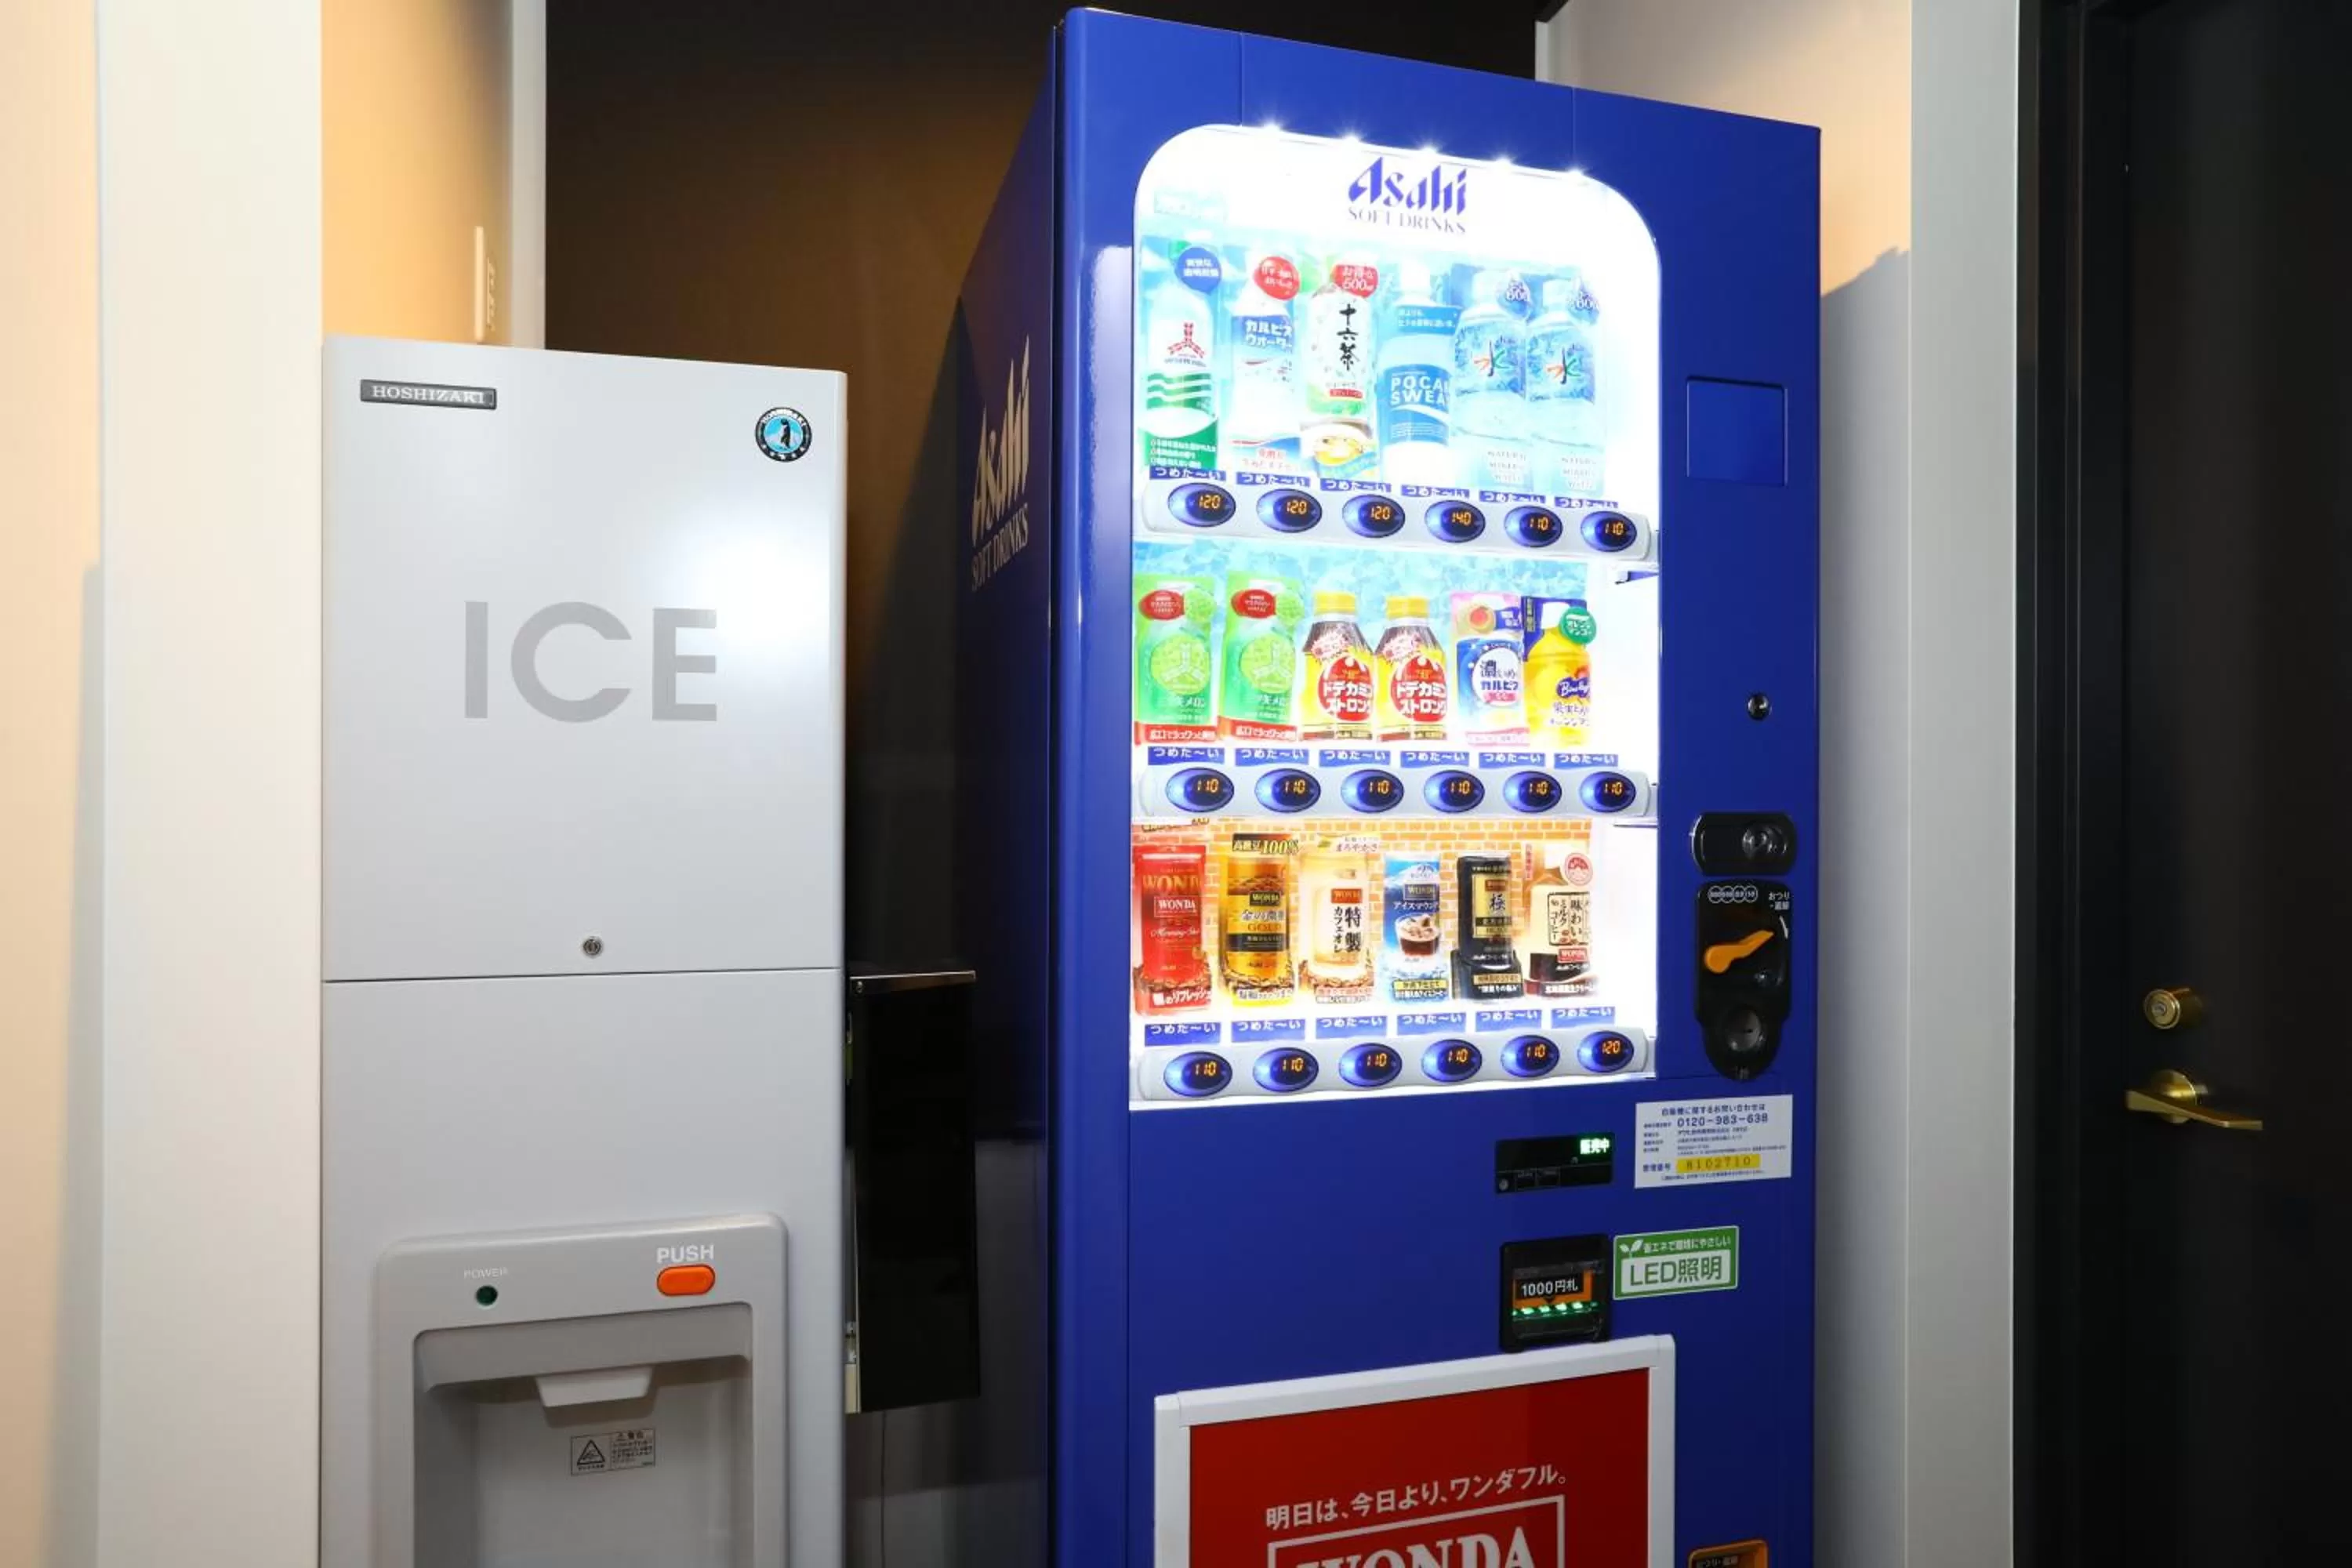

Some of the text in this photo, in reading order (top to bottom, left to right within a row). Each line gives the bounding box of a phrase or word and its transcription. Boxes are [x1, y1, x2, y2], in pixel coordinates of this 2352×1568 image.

[1347, 156, 1468, 216] Asahi
[1348, 206, 1467, 234] SOFT DRINKS
[1337, 303, 1360, 371] 十六茶
[372, 385, 485, 405] HOSHIZAKI
[1200, 495, 1221, 509] 120
[1287, 501, 1307, 514] 120
[1371, 506, 1390, 520] 120
[1452, 512, 1472, 524] 140
[1530, 517, 1548, 530] 110
[1606, 522, 1624, 535] 110
[464, 601, 717, 723] ICE
[1196, 779, 1219, 793] 110
[1284, 779, 1305, 793] 110
[1368, 780, 1389, 793] 110
[1450, 780, 1470, 794] 110
[1529, 780, 1548, 794] 110
[1604, 781, 1623, 794] 110
[1158, 899, 1196, 913] WONDA
[1345, 906, 1361, 952] 特製
[1526, 1044, 1545, 1058] 110
[1602, 1040, 1621, 1054] 120
[1367, 1053, 1387, 1067] 110
[1448, 1048, 1468, 1062] 110
[1195, 1061, 1217, 1076] 110
[1282, 1058, 1305, 1072] 110
[656, 1244, 715, 1265] PUSH
[1630, 1255, 1722, 1287] LED照明
[1521, 1278, 1579, 1298] 1000円札
[1265, 1464, 1567, 1531] 明日は、今日より、ワンダフル。
